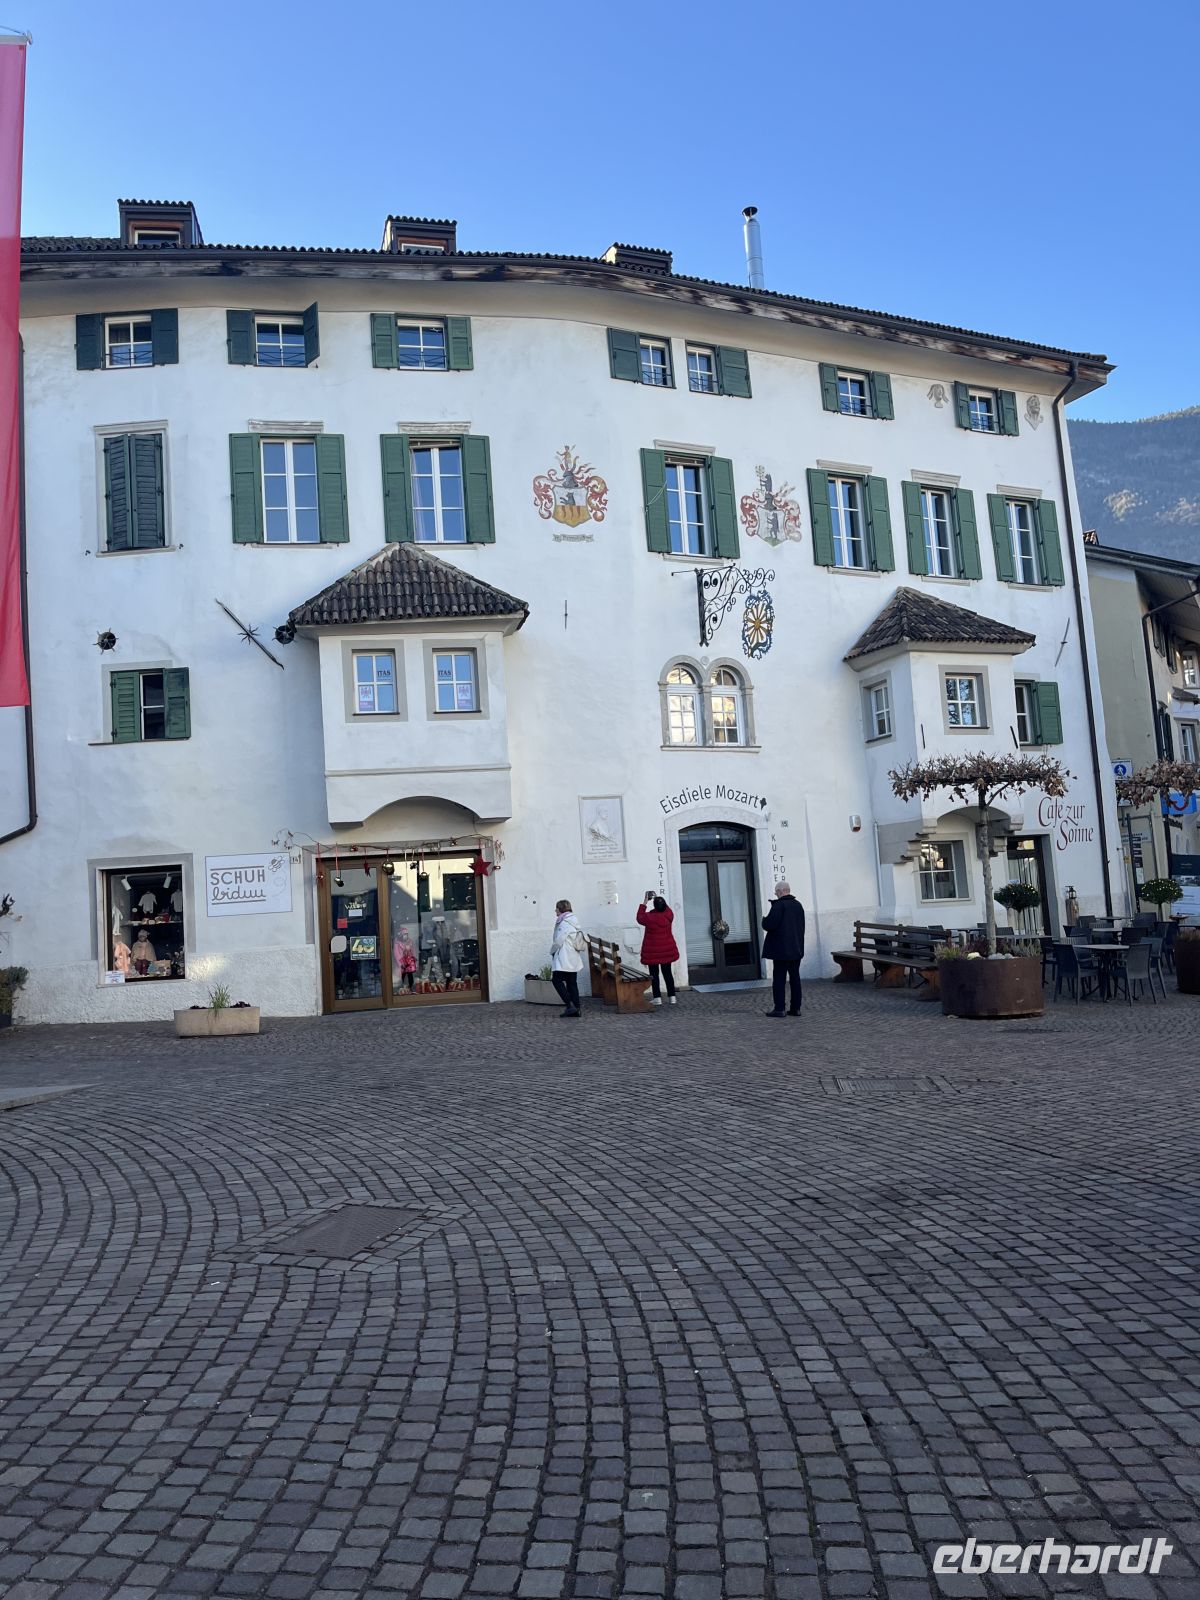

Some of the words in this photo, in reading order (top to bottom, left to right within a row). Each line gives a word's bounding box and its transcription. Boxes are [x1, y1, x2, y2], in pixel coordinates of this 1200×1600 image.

[660, 785, 711, 814] Eisdiele
[715, 785, 758, 808] Mozart
[1066, 804, 1086, 826] zur
[1056, 819, 1094, 851] Sonne
[656, 838, 665, 895] GELATER
[770, 833, 779, 882] KUCHE
[210, 869, 265, 886] SCHUH
